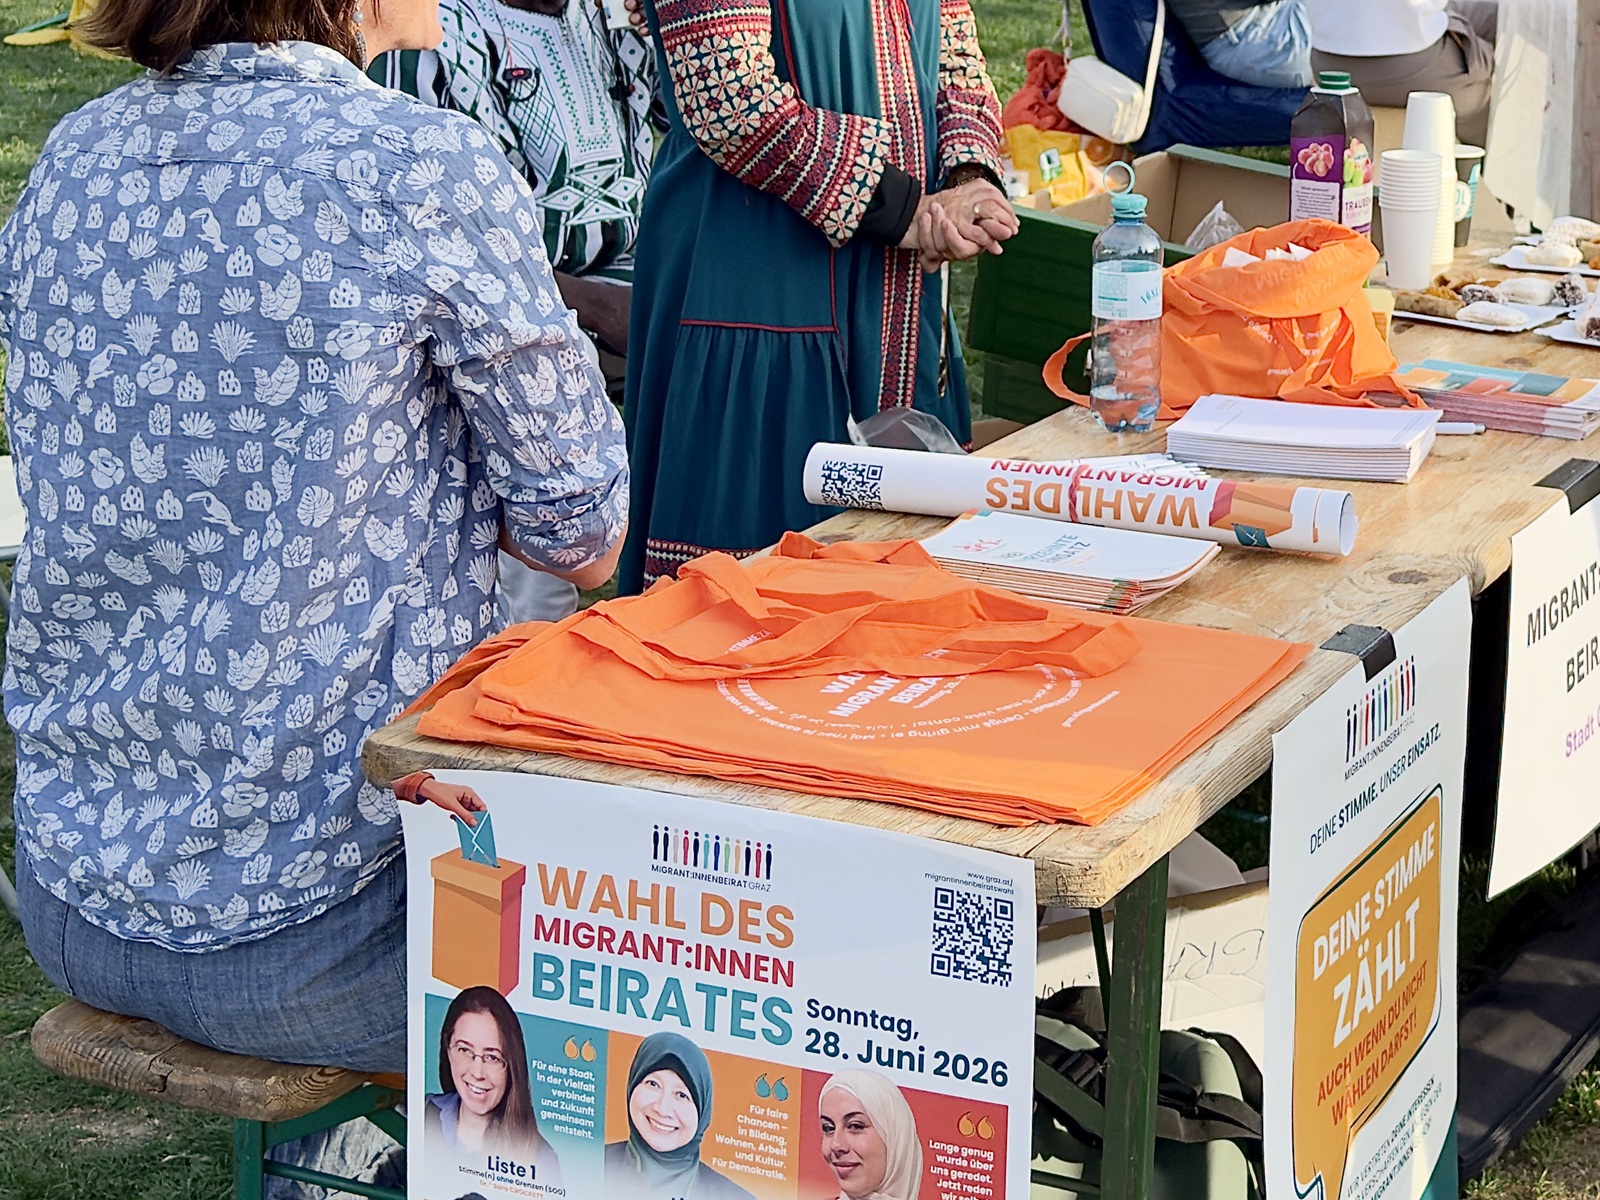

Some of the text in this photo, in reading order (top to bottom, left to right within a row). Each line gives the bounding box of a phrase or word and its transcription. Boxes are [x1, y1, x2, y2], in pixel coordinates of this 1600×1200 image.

[990, 460, 1208, 490] MIGRANTINNEN
[985, 477, 1200, 529] WAHL DES
[828, 674, 901, 717] MIGRAN
[888, 676, 943, 705] BEIRA
[1564, 714, 1595, 760] Stadt
[1310, 722, 1442, 855] DEINE STIMME. UNSER EINSATZ.
[651, 864, 771, 892] MIGRANT:INNENBEIRAT GRAZ
[537, 863, 794, 948] WAHL DES
[1313, 821, 1435, 982] DEINE STIMME
[534, 914, 794, 988] MIGRANT:INNEN
[1333, 897, 1420, 1049] ZÄHLT
[532, 952, 793, 1046] BEIRATES
[806, 998, 920, 1042] Sonntag,
[1317, 960, 1427, 1107] AUCH WENN DU NICHT
[804, 1028, 1009, 1088] 28. Juni 2026
[1331, 1006, 1418, 1126] WÄHLEN DARFST!
[532, 1060, 596, 1082] Für eine Stadt,
[536, 1072, 596, 1093] in der Vielfalt
[541, 1098, 595, 1117] und Zukunft
[551, 1088, 595, 1105] verbindet
[540, 1110, 594, 1128] gemeinsam
[736, 1114, 780, 1131] Chancen
[749, 1105, 788, 1120] Für faire
[553, 1124, 594, 1140] entsteht.
[738, 1126, 787, 1146] in Bildung,
[715, 1133, 787, 1157] Wohnen, Arbeit
[929, 1139, 994, 1160] Lange genug
[487, 1155, 537, 1180] Liste 1
[712, 1157, 787, 1181] Für Demokratie.
[735, 1150, 787, 1169] und Kultur.
[936, 1154, 994, 1172] wurde über
[496, 1175, 514, 1185] ohne
[515, 1179, 544, 1191] Grenzen
[930, 1165, 993, 1184] uns geredet.
[936, 1178, 993, 1196] Jetzt reden
